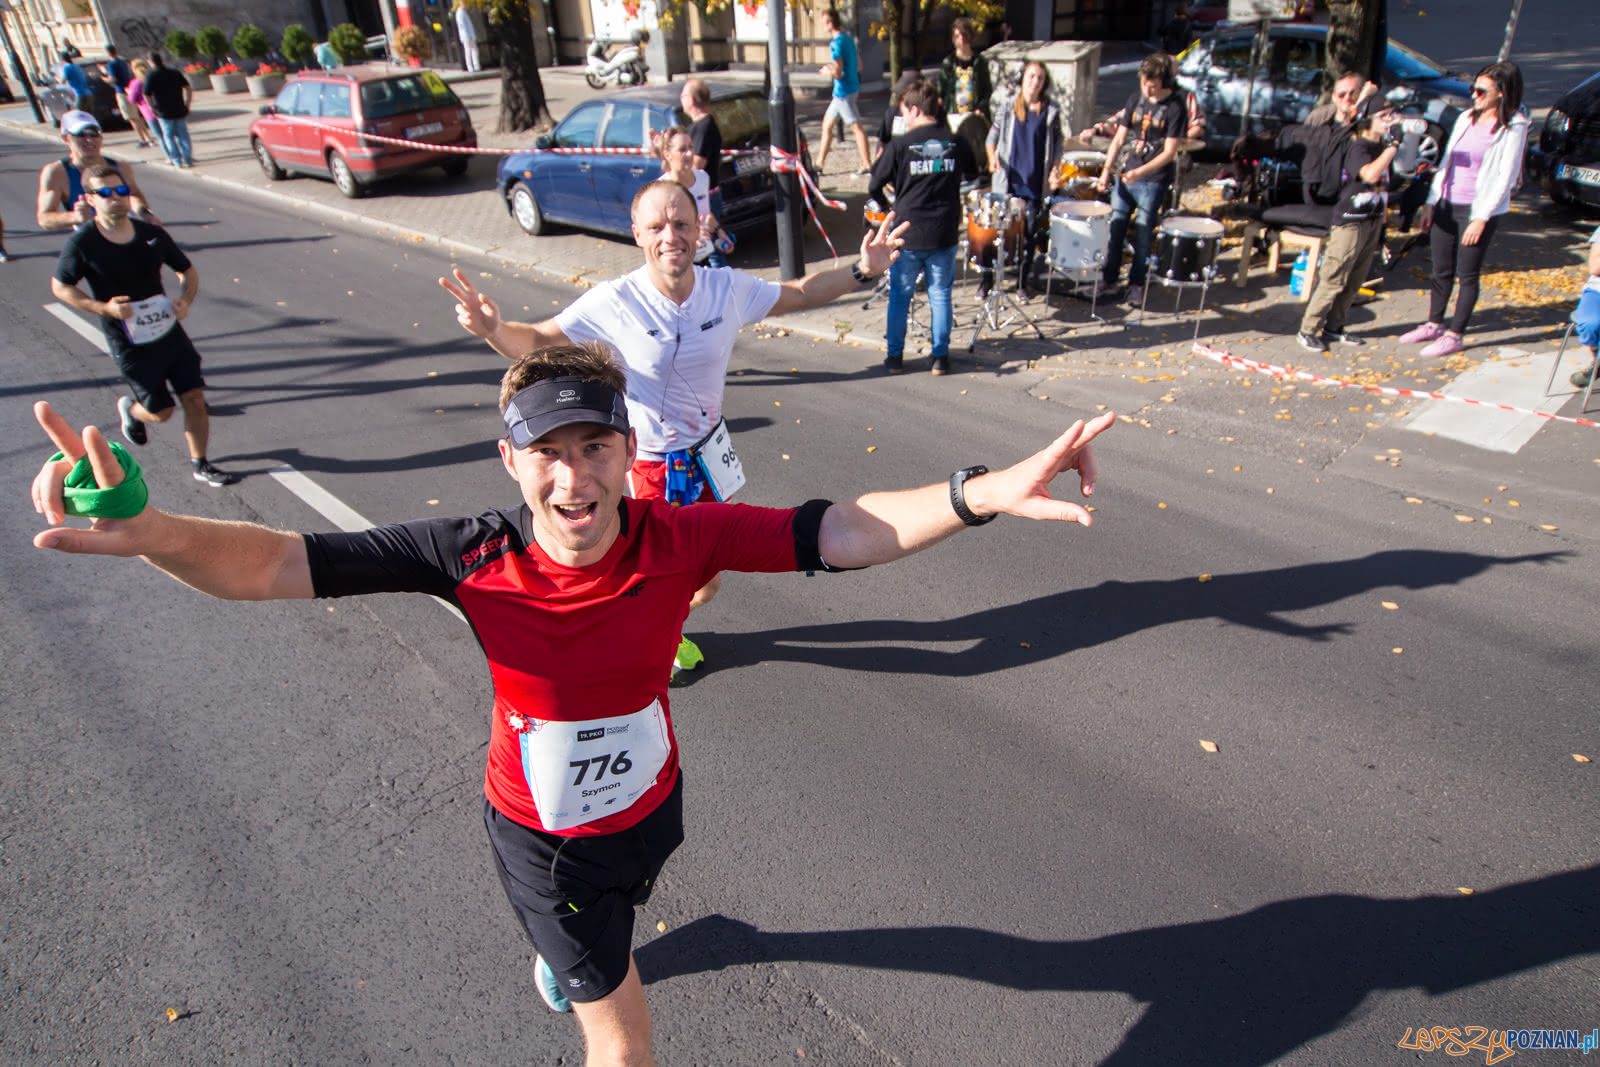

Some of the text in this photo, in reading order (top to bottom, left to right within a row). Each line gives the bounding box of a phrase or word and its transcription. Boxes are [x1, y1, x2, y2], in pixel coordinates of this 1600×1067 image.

[136, 310, 169, 325] 4324
[590, 730, 603, 738] PKO
[569, 750, 633, 786] 776
[581, 782, 621, 798] Szymon
